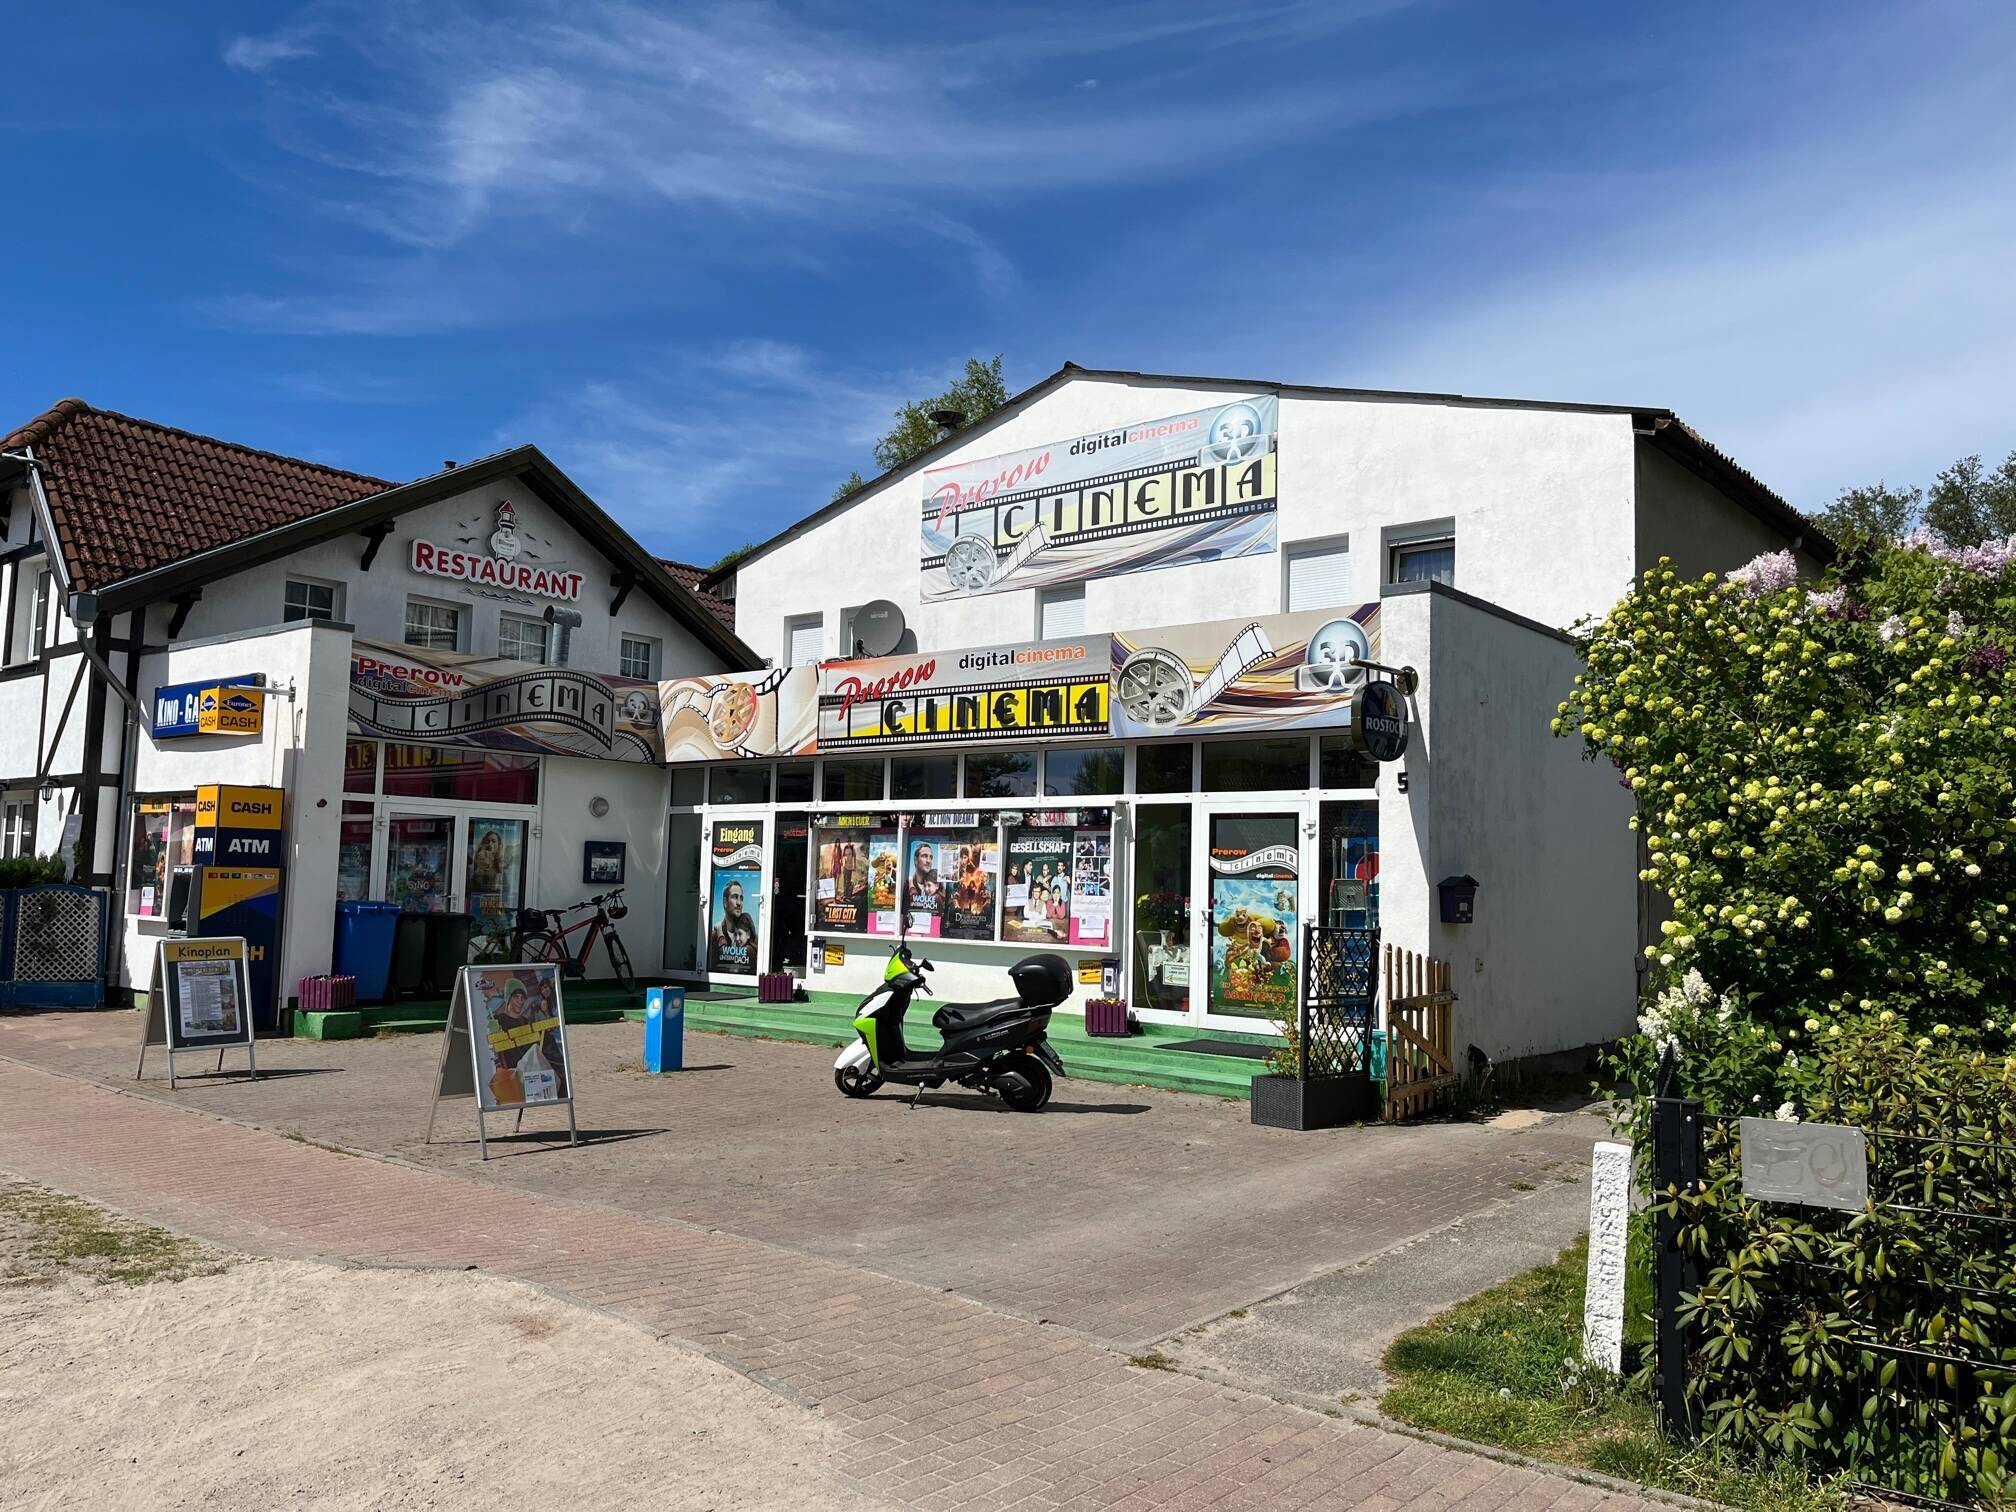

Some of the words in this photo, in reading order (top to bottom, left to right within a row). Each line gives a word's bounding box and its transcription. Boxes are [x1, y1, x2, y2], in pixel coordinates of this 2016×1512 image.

[1069, 417, 1200, 456] digitalcinema
[930, 451, 1053, 532] Prerow
[1003, 459, 1262, 539] CINEMA
[416, 542, 582, 598] RESTAURANT
[958, 644, 1086, 671] digitalcinema
[357, 655, 464, 687] Prerow
[356, 675, 463, 700] digitalcinema
[834, 658, 936, 721] Prerow
[226, 700, 252, 709] Euronet
[424, 678, 606, 729] CINEMA
[884, 685, 1099, 734] CINEMA
[200, 716, 216, 728] CASH
[220, 715, 257, 729] CASH
[1397, 772, 1409, 795] 5
[198, 800, 216, 812] CASH
[231, 801, 272, 815] CASH
[720, 827, 755, 844] Eingang
[195, 837, 214, 853] ATM
[228, 838, 270, 854] ATM
[1010, 841, 1071, 853] GESELLSCHAFT
[1212, 848, 1247, 856] Prerow
[1234, 851, 1294, 869] cinema
[912, 895, 936, 903] WOLKE
[842, 907, 858, 920] CITY
[178, 946, 231, 958] Kinoplan
[722, 946, 748, 956] WOLKE
[734, 956, 750, 964] DACH
